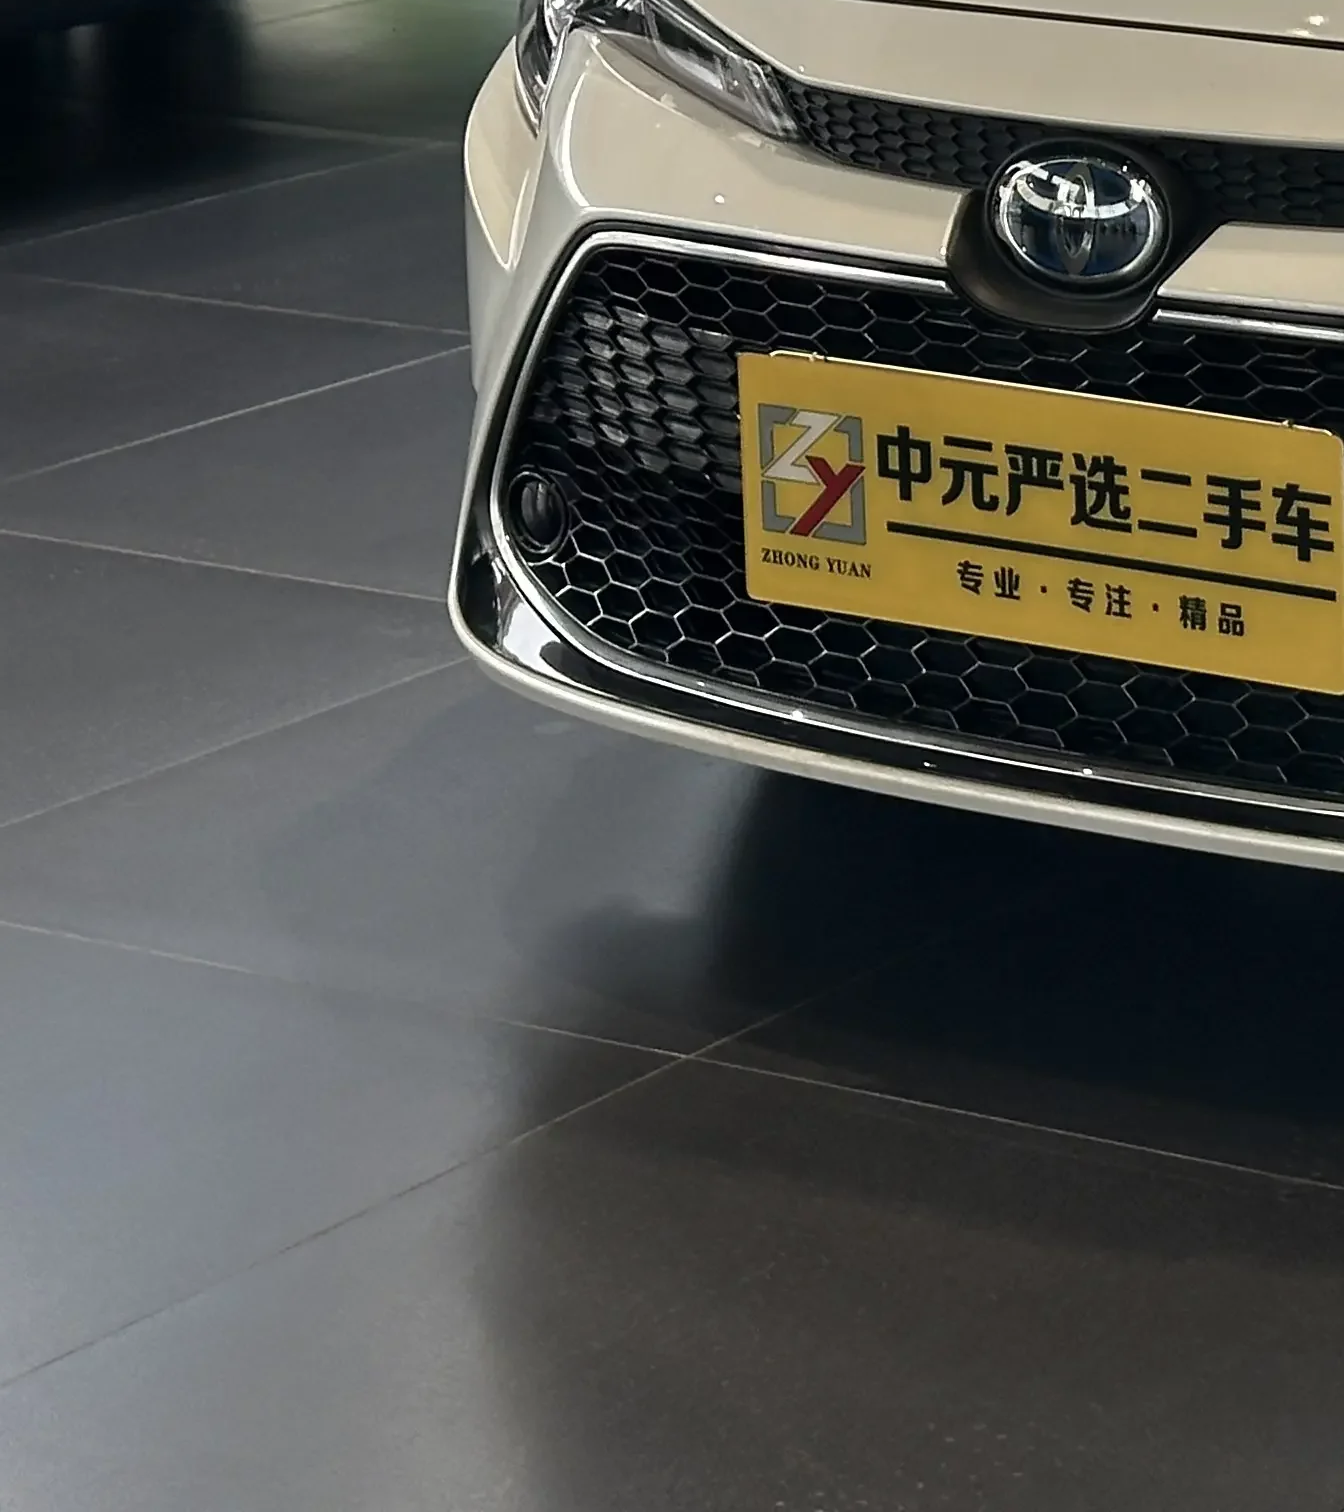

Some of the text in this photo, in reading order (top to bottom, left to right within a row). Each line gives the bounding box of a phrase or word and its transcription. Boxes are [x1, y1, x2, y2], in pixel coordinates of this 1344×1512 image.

[876, 425, 1335, 562] 中元严选二手车
[761, 547, 872, 579] ZHONG YUAN
